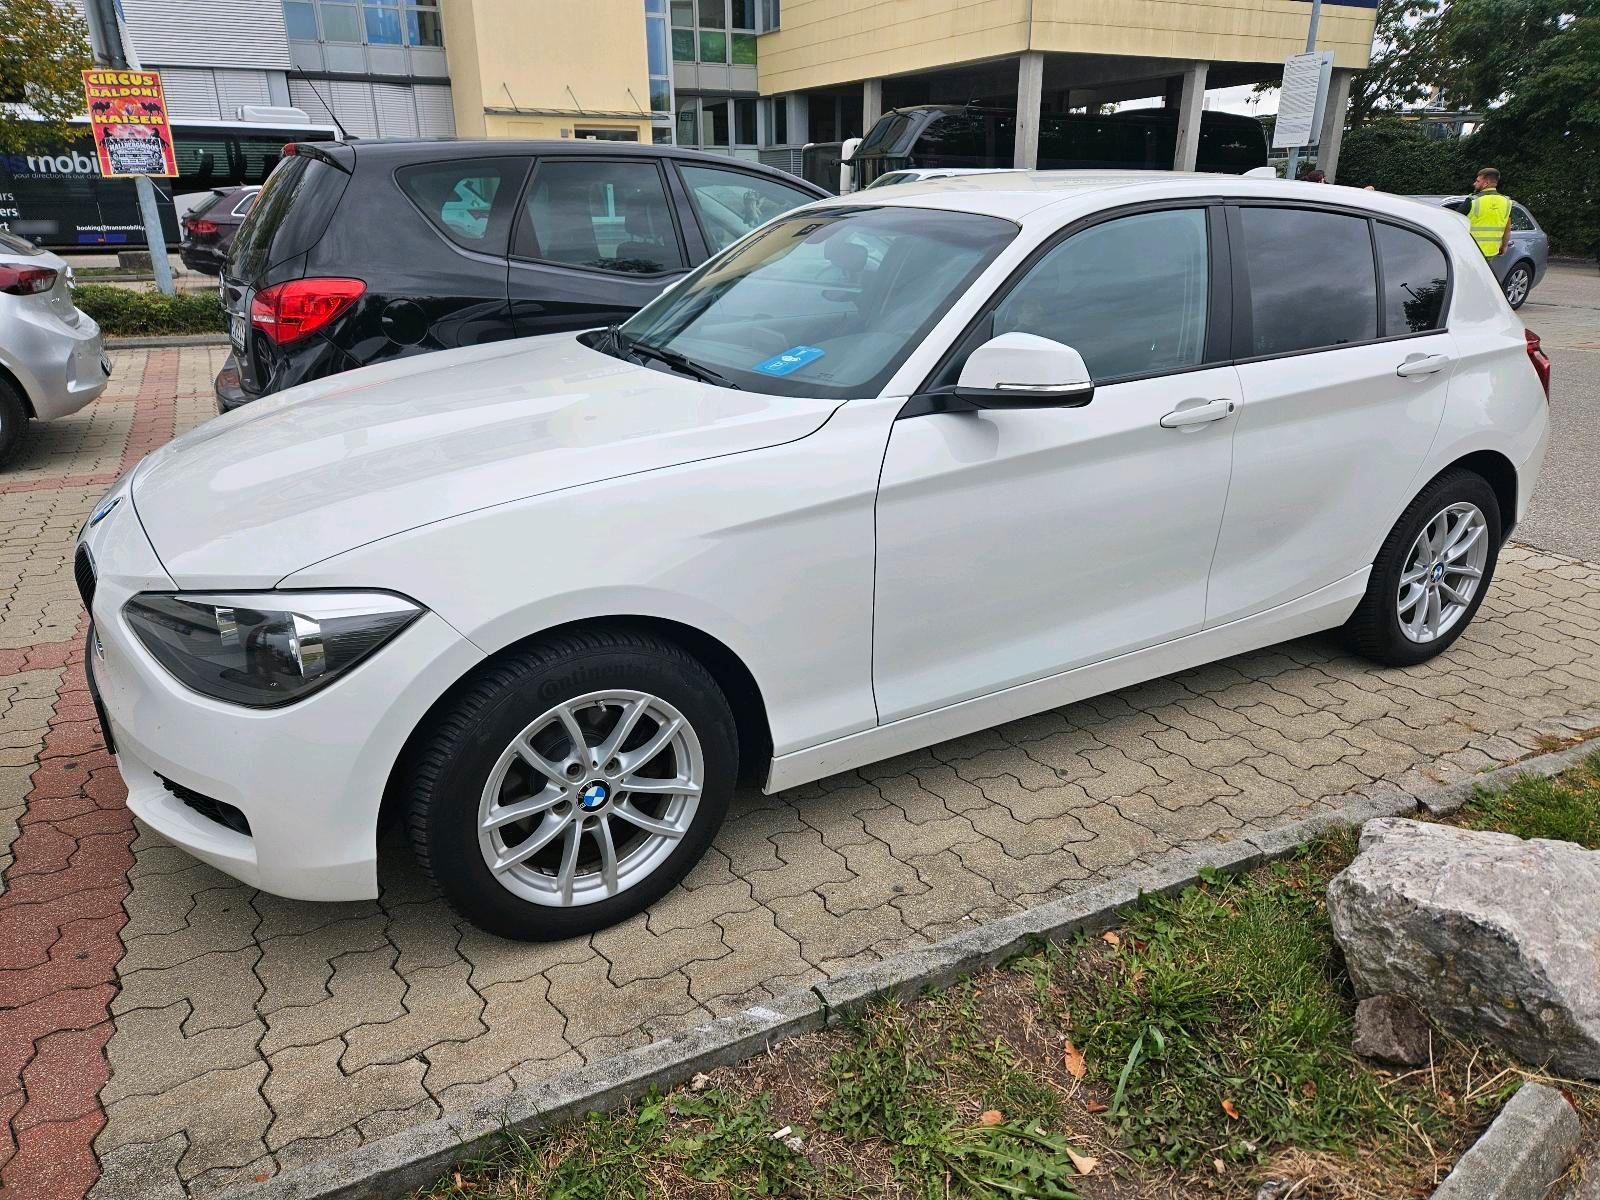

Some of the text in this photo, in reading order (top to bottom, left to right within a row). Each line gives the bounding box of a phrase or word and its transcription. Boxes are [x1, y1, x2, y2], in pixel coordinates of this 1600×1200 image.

[88, 73, 154, 86] CIRCUS
[89, 87, 158, 97] BALDONI
[94, 114, 164, 124] KAISER
